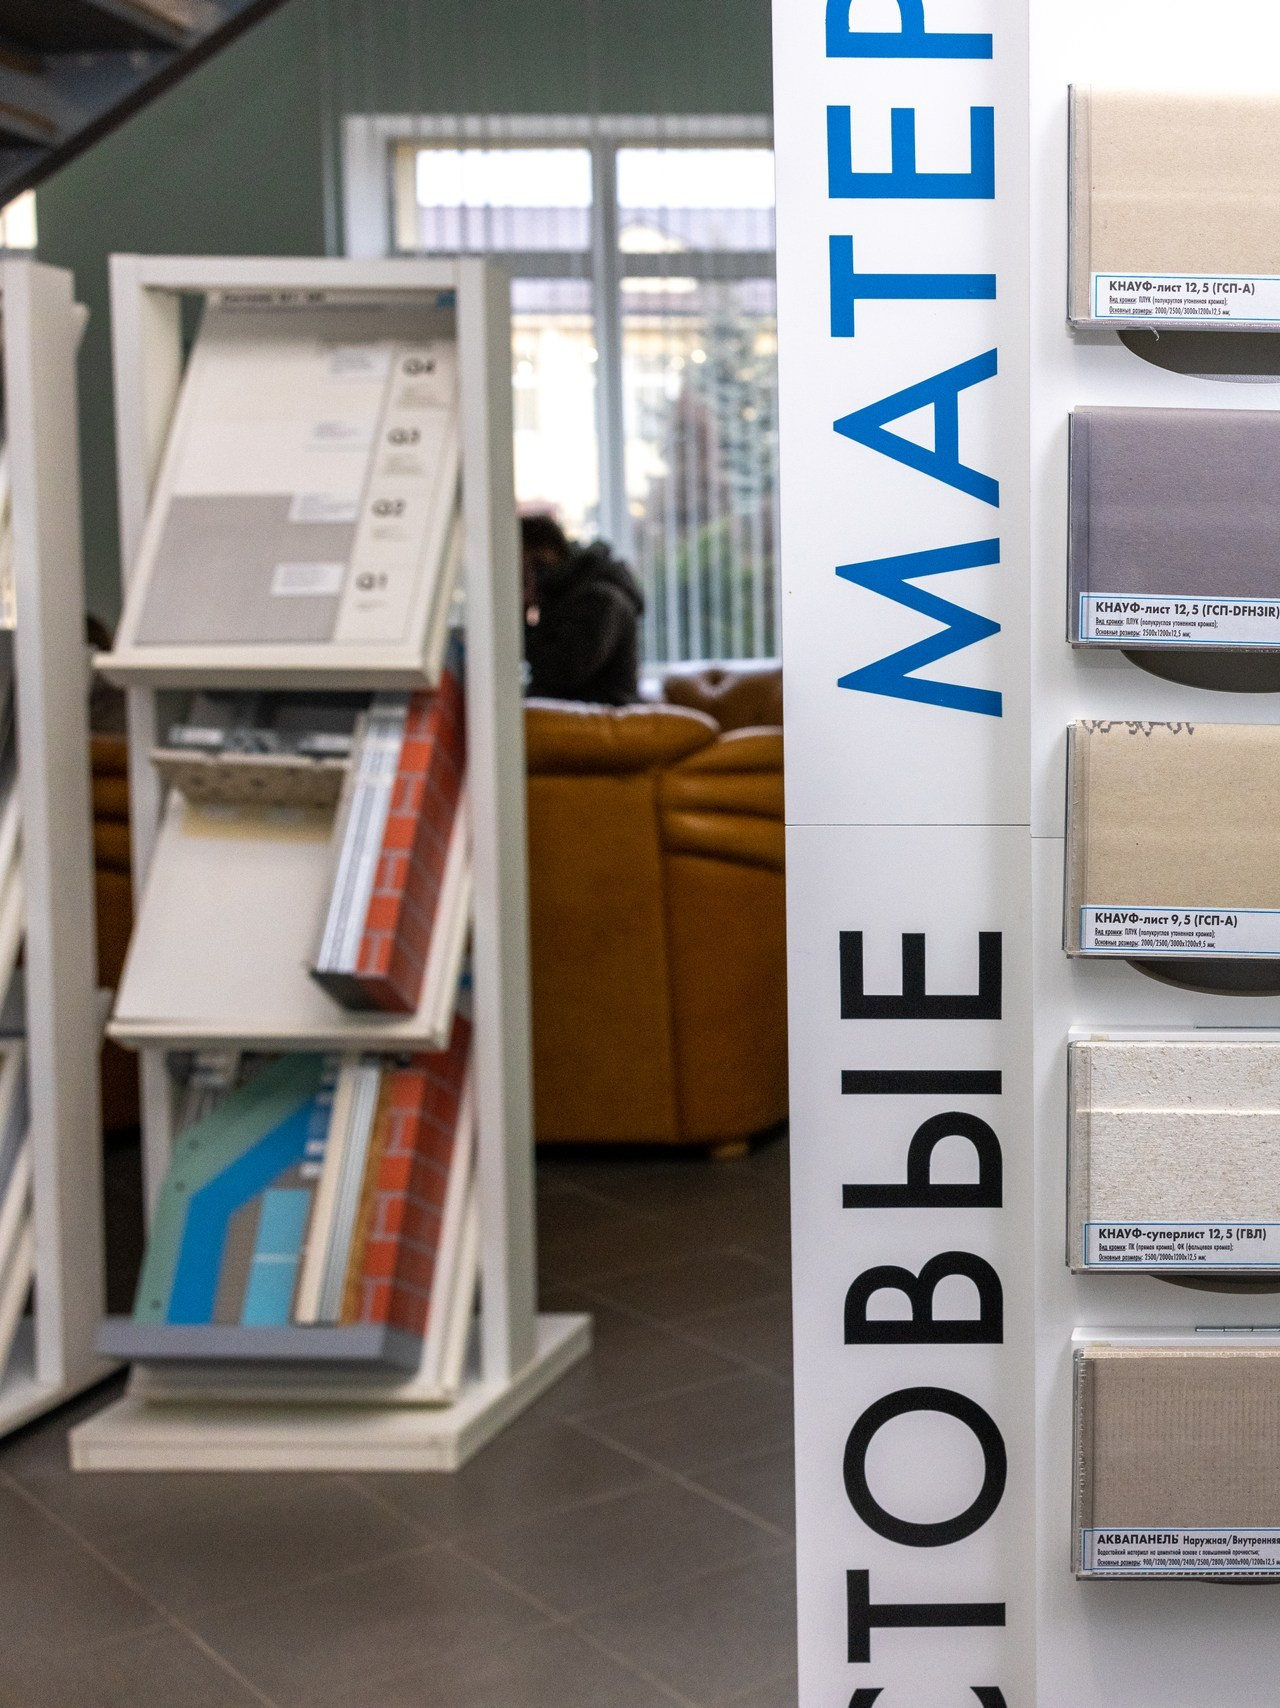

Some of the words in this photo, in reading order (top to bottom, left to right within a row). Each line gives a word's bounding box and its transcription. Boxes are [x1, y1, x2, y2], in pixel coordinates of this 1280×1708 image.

[1109, 281, 1181, 292] КНАУФ-лист
[825, 0, 1003, 717] МАТЕР
[1095, 602, 1170, 614] КНАУФ-лист
[1095, 913, 1168, 924] КНАУФ-лист
[1098, 1228, 1205, 1241] КНАУФ-суперлист
[1236, 1229, 1266, 1240] (ГВЛ)
[839, 930, 1007, 1708] ТОВЫЕ
[1183, 1535, 1280, 1547] Наружная/Внутренняя
